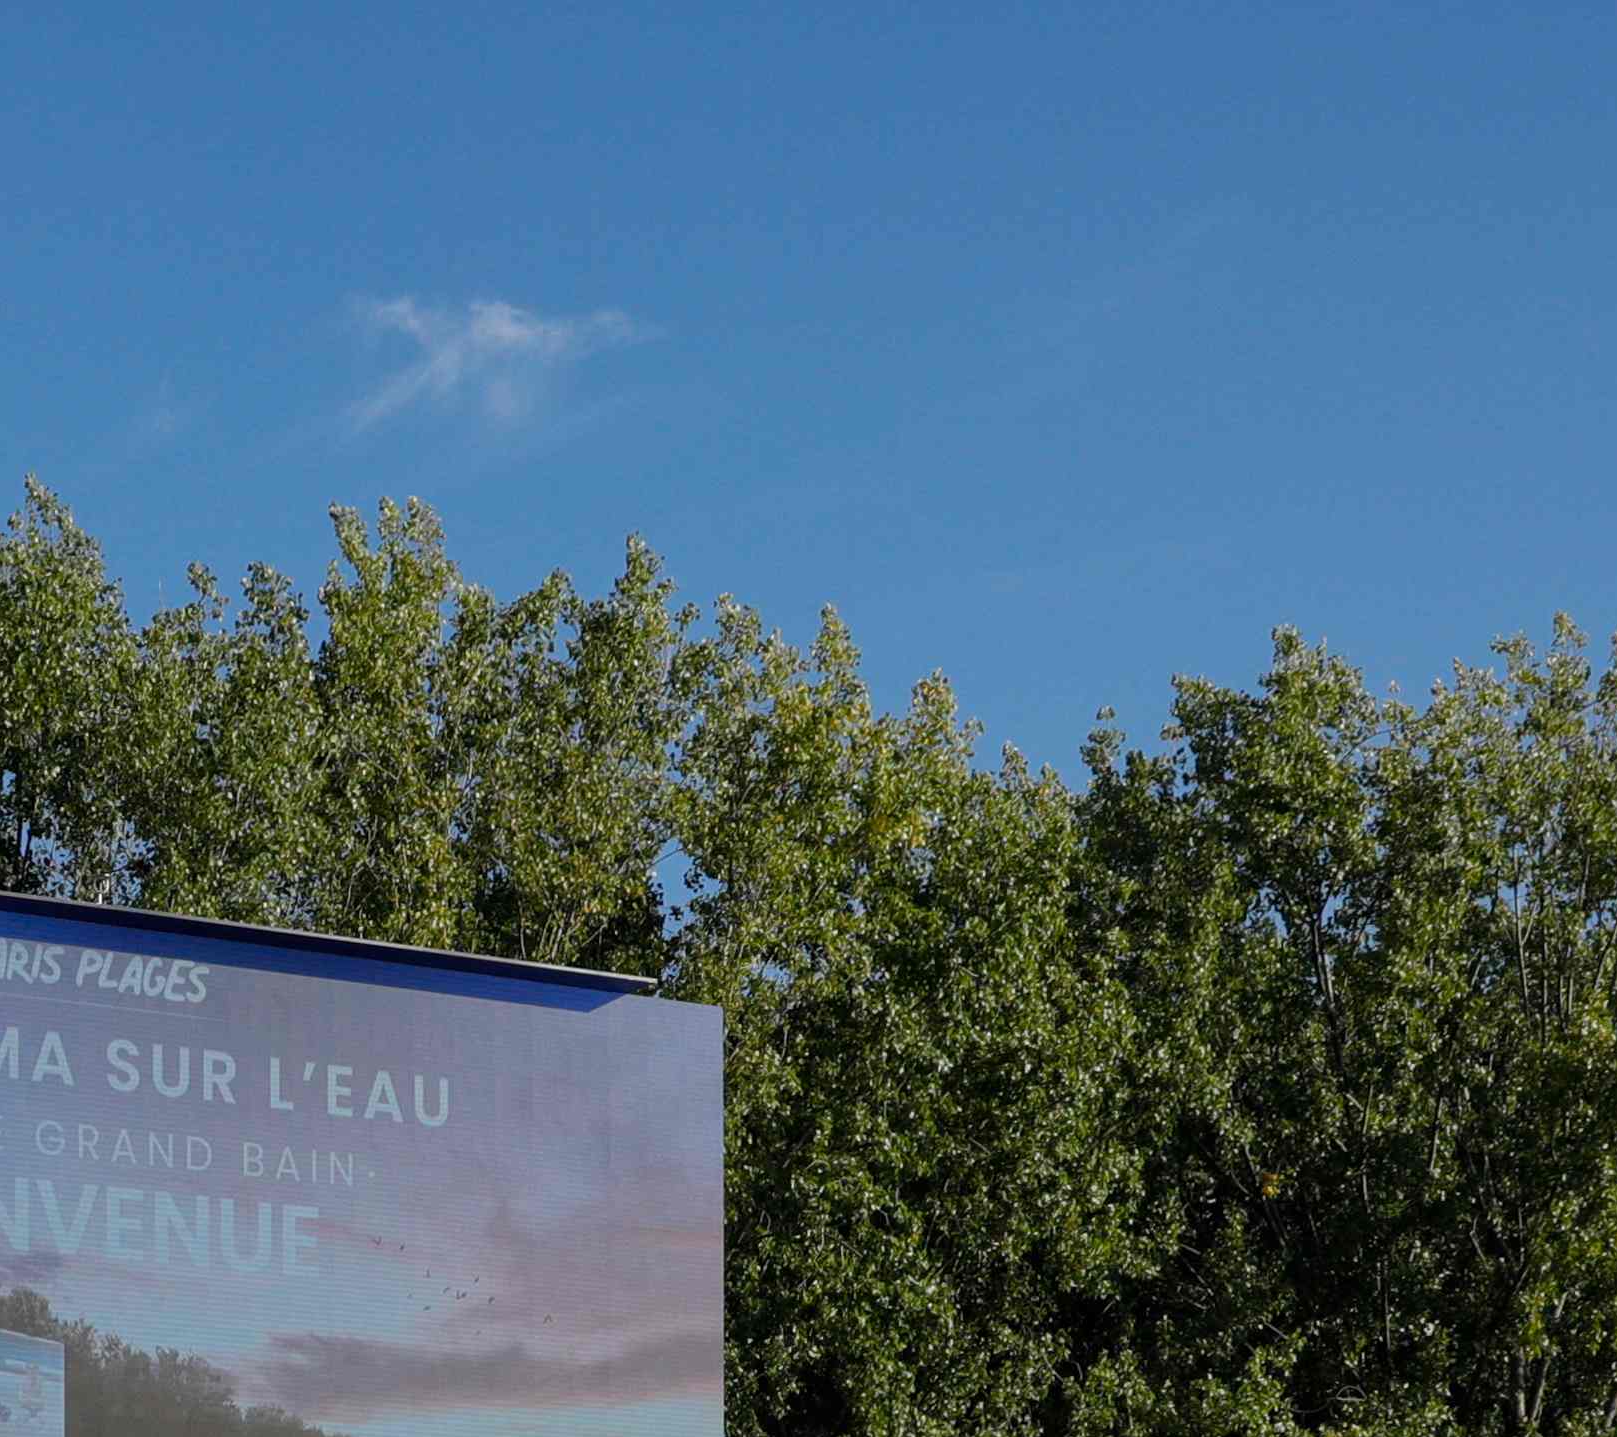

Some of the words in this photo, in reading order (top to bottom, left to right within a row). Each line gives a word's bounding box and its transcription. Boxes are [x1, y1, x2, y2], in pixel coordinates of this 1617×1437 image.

[75, 949, 210, 1003] PLAGES
[105, 1038, 238, 1105] SUR
[269, 1056, 450, 1128] L'EAU
[34, 1119, 213, 1171] GRAND
